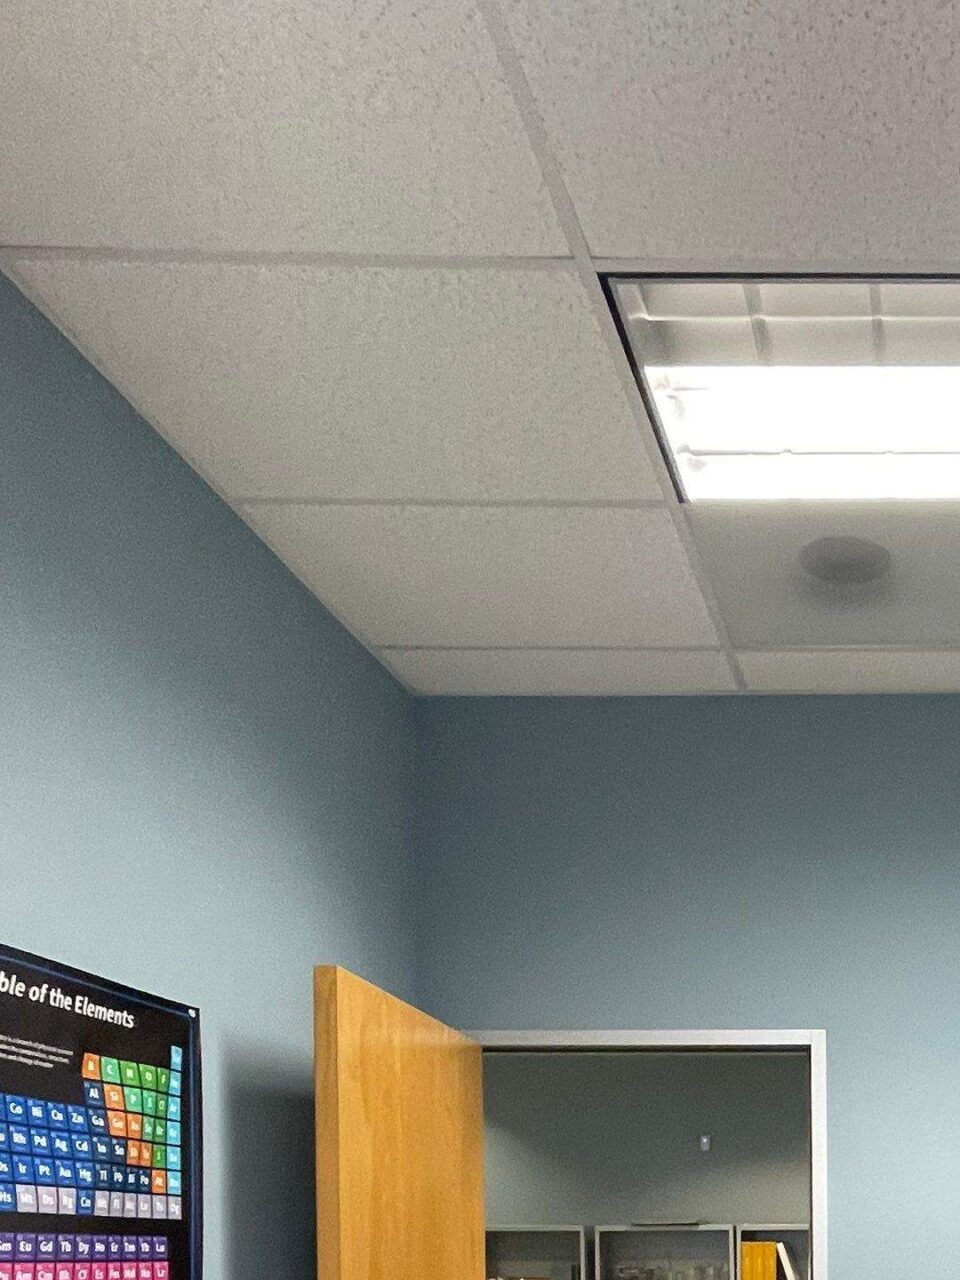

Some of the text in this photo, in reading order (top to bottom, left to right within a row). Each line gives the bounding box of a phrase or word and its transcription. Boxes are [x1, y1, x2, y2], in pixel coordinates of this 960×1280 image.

[29, 983, 48, 1003] of
[50, 988, 72, 1011] the
[75, 995, 134, 1028] Elements
[89, 1088, 99, 1099] Al
[71, 1113, 83, 1123] Zn
[34, 1135, 47, 1147] Pd
[76, 1140, 88, 1151] Cd
[39, 1164, 50, 1176] Pt
[79, 1169, 92, 1182] Hg
[40, 1241, 53, 1252] Gd
[60, 1241, 72, 1252] Tb
[78, 1241, 89, 1254] Dy
